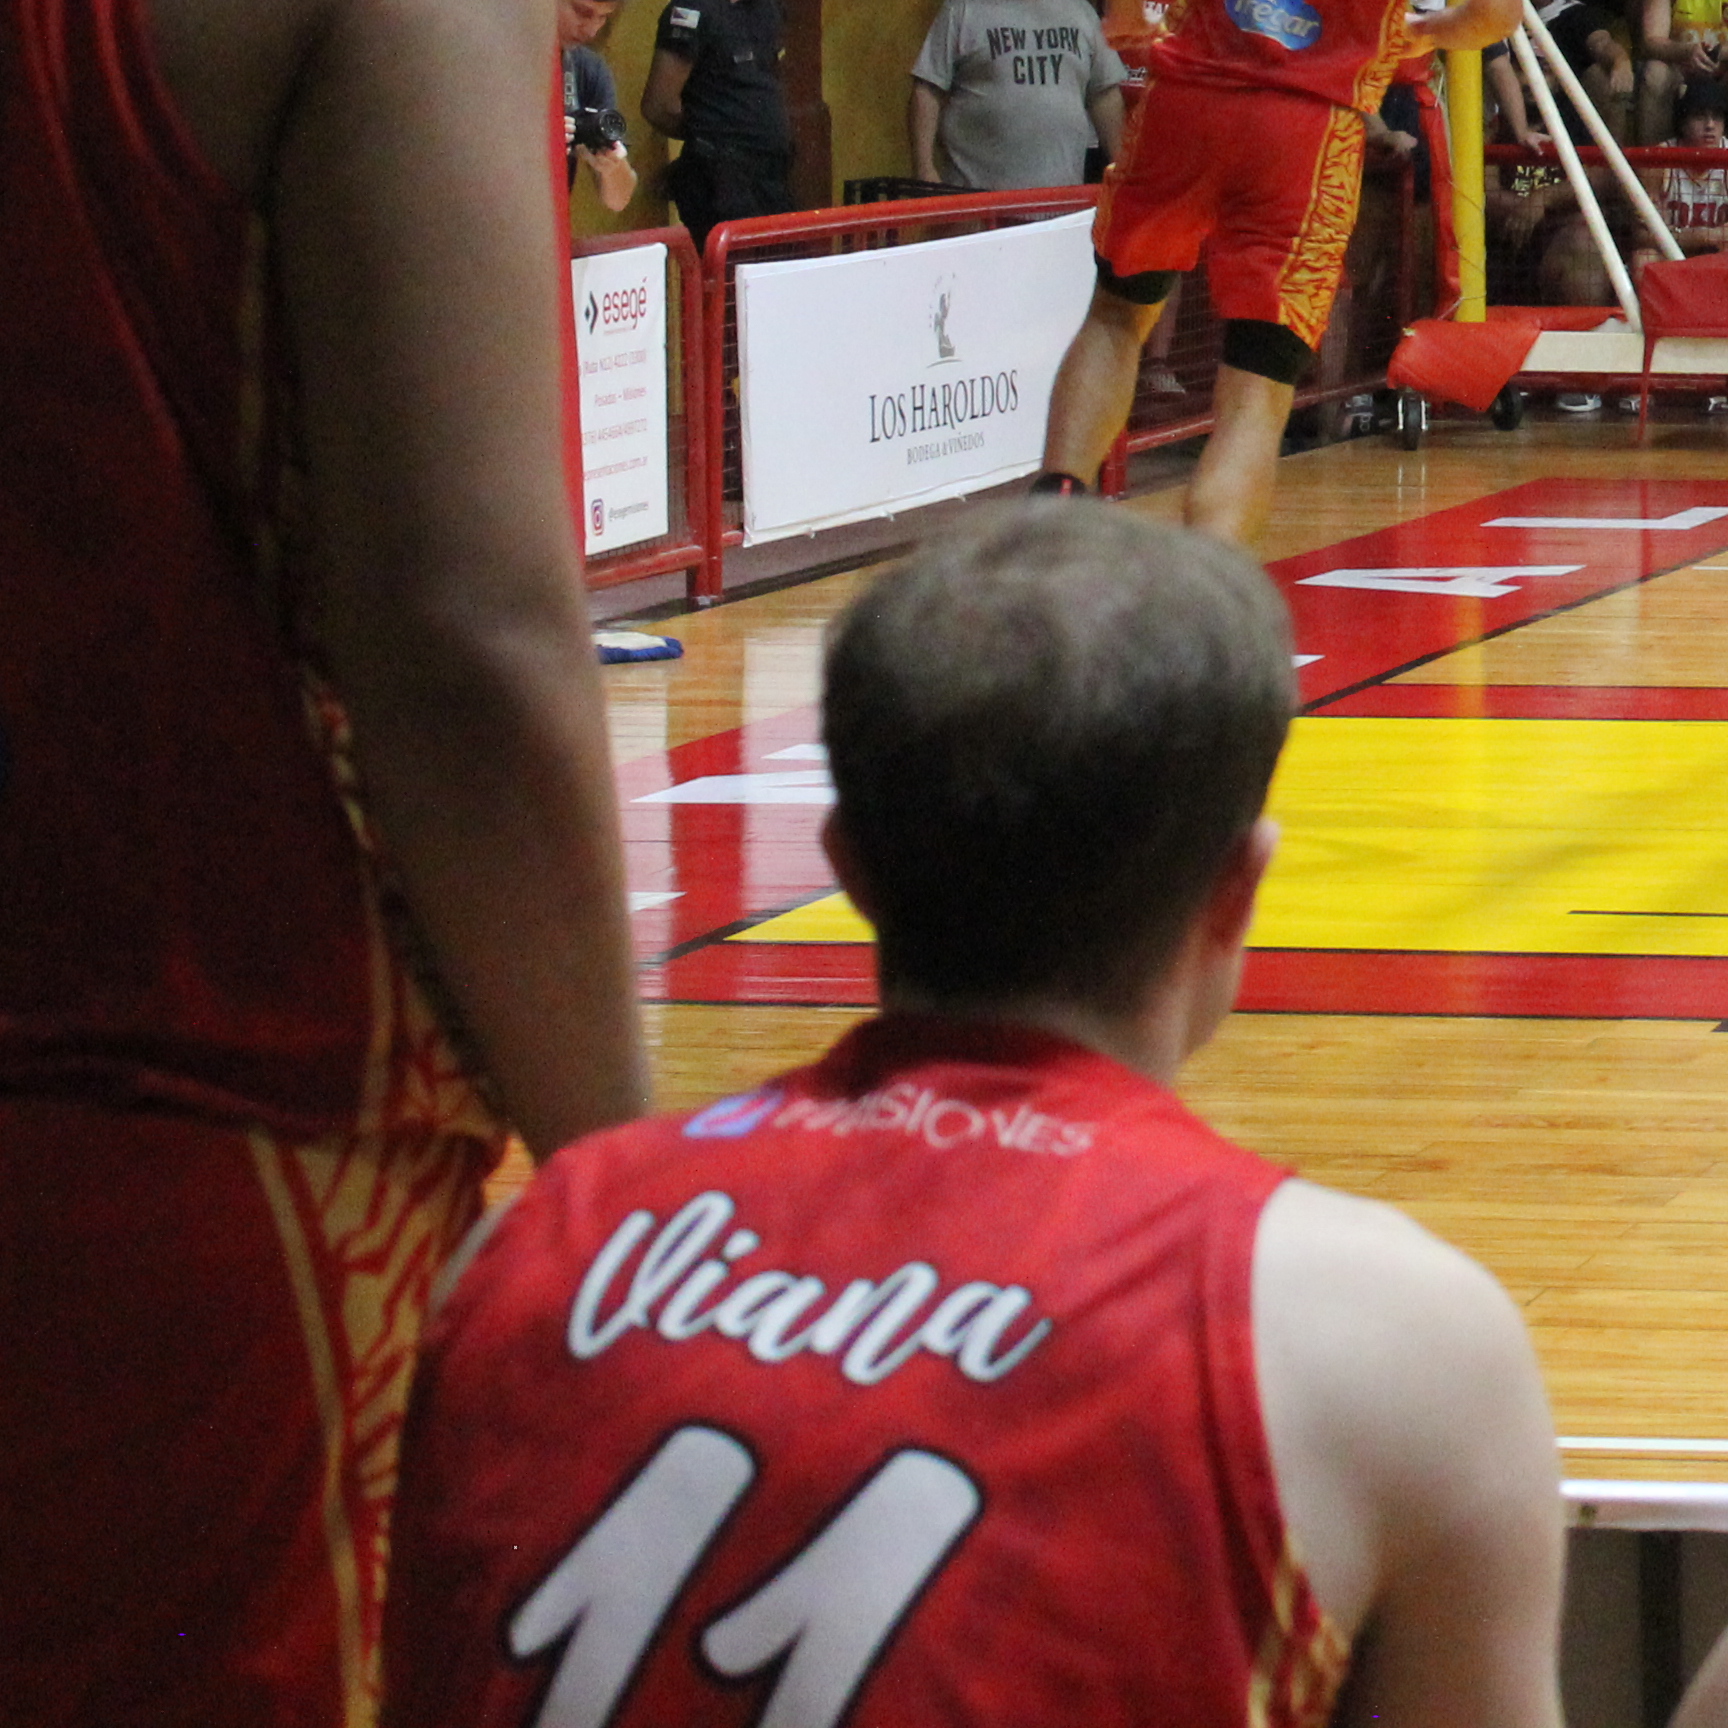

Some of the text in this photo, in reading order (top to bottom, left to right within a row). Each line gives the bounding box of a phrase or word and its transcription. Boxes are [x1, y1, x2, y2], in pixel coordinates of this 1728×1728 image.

[986, 26, 1082, 60] NEW YORK
[1013, 53, 1065, 85] CITY
[602, 276, 648, 330] esegé
[869, 369, 1019, 444] LOS HAROLDOS
[907, 443, 941, 465] BODEGA
[566, 1190, 1054, 1388] Viana
[507, 1423, 982, 1728] 11
